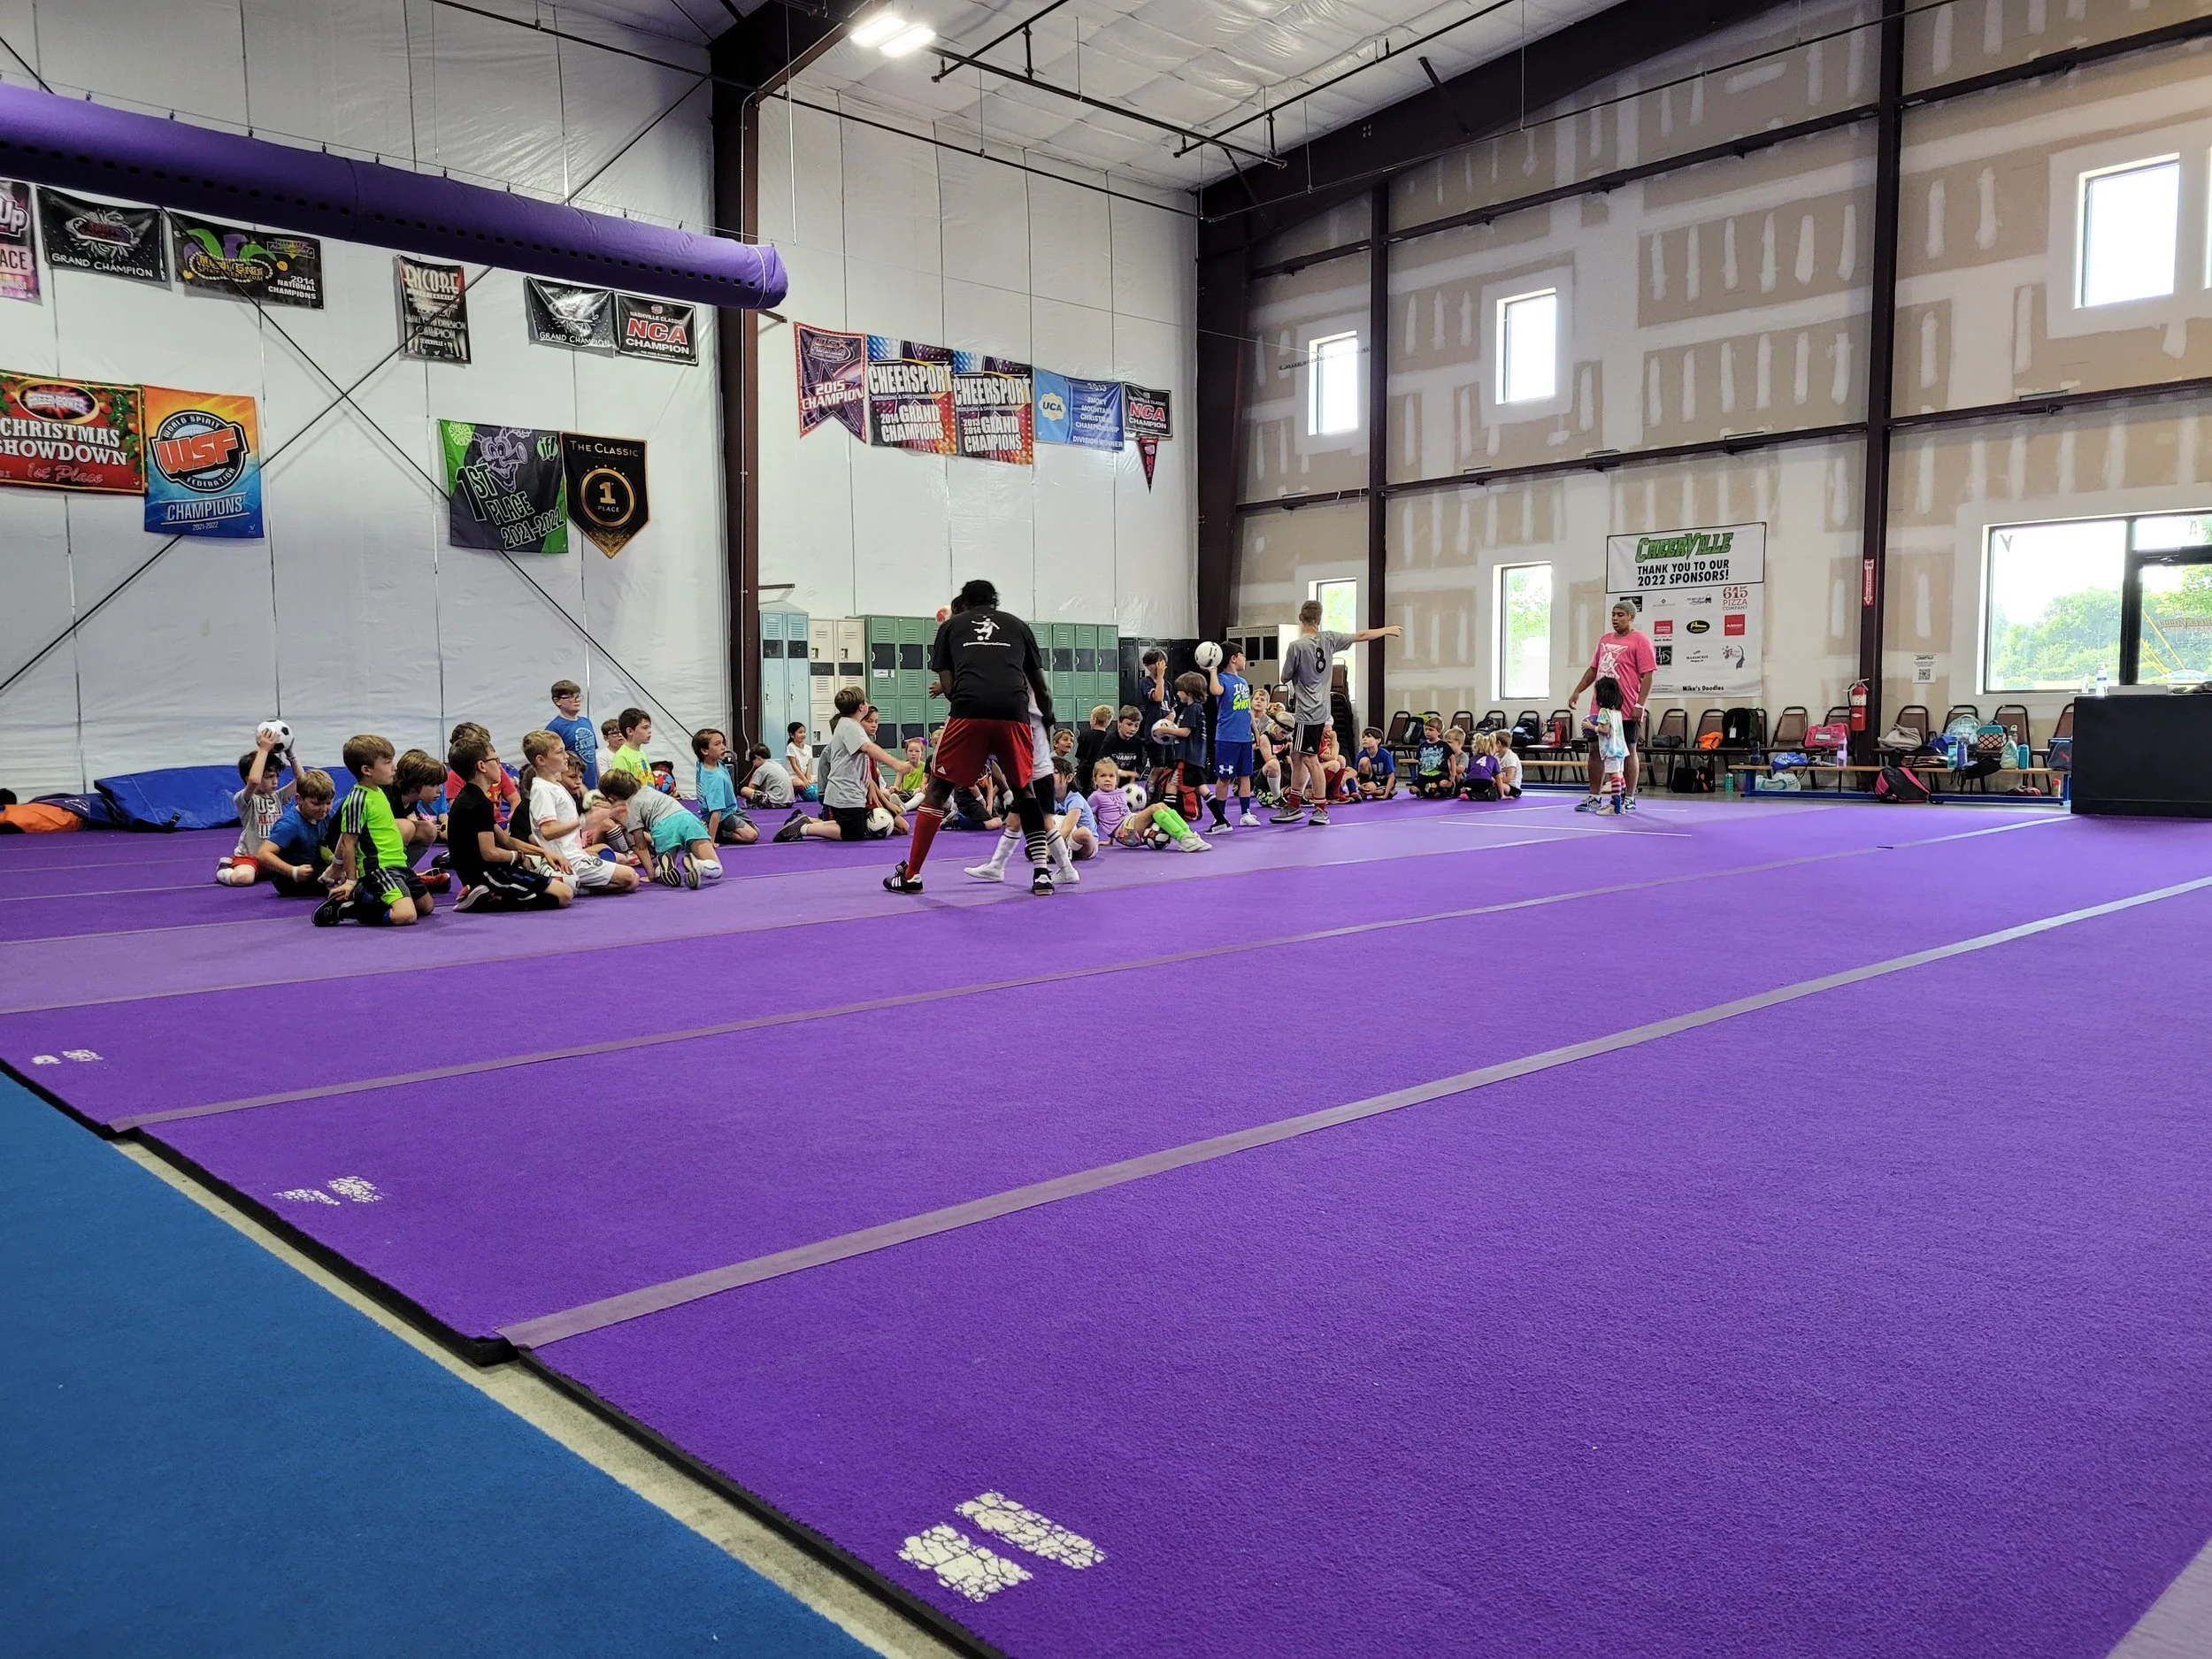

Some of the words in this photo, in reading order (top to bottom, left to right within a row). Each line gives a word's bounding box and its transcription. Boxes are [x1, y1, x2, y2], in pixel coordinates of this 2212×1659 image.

[51, 252, 91, 267] GRAND
[93, 261, 154, 278] CHAMPION
[277, 279, 317, 292] NATIONAL
[290, 275, 315, 286] 2014
[267, 285, 317, 300] CHAMPIONS
[630, 311, 659, 321] NASHVILLE
[659, 315, 684, 325] CLASSIC
[539, 331, 567, 342] GRAND
[626, 319, 687, 344] NCA
[626, 338, 689, 354] CHAMPION
[815, 380, 845, 396] 2015
[868, 365, 953, 395] CHEERSPORT
[802, 386, 864, 410] CHAMPION
[953, 378, 1032, 405] CHEERSPORT
[880, 413, 900, 424] 2014
[899, 404, 941, 423] GRAND
[1042, 401, 1063, 411] UCA
[1129, 402, 1166, 422] NCA
[163, 416, 188, 438] WORLD
[189, 415, 221, 430] SPIRIT
[881, 420, 944, 442] CHAMPIONS
[980, 416, 1020, 434] GRAND
[1075, 420, 1120, 434] CHAMPIONSHIP
[1128, 417, 1167, 430] CHAMPION
[0, 417, 121, 449] CHRISTMAS
[155, 426, 239, 475] WSF
[569, 440, 592, 452] THE
[595, 442, 639, 457] CLASSIC
[964, 434, 1023, 452] CHAMPIONS
[55, 465, 104, 484] Place
[187, 468, 236, 488] FEDERATION
[456, 464, 497, 522] 1ST
[166, 495, 244, 521] CHAMPIONS
[487, 490, 535, 526] PLACE
[192, 521, 219, 531] 2021-2022
[501, 507, 565, 550] 2021-2022
[1638, 564, 1669, 575] THANK
[1671, 562, 1691, 572] YOU
[1694, 561, 1706, 572] TO
[1709, 559, 1730, 570] OUR
[1638, 574, 1665, 587] 2022
[1669, 569, 1730, 585] SPONSORS!
[1723, 586, 1748, 599] 615
[1315, 647, 1326, 673] 8
[1476, 756, 1487, 767] 4
